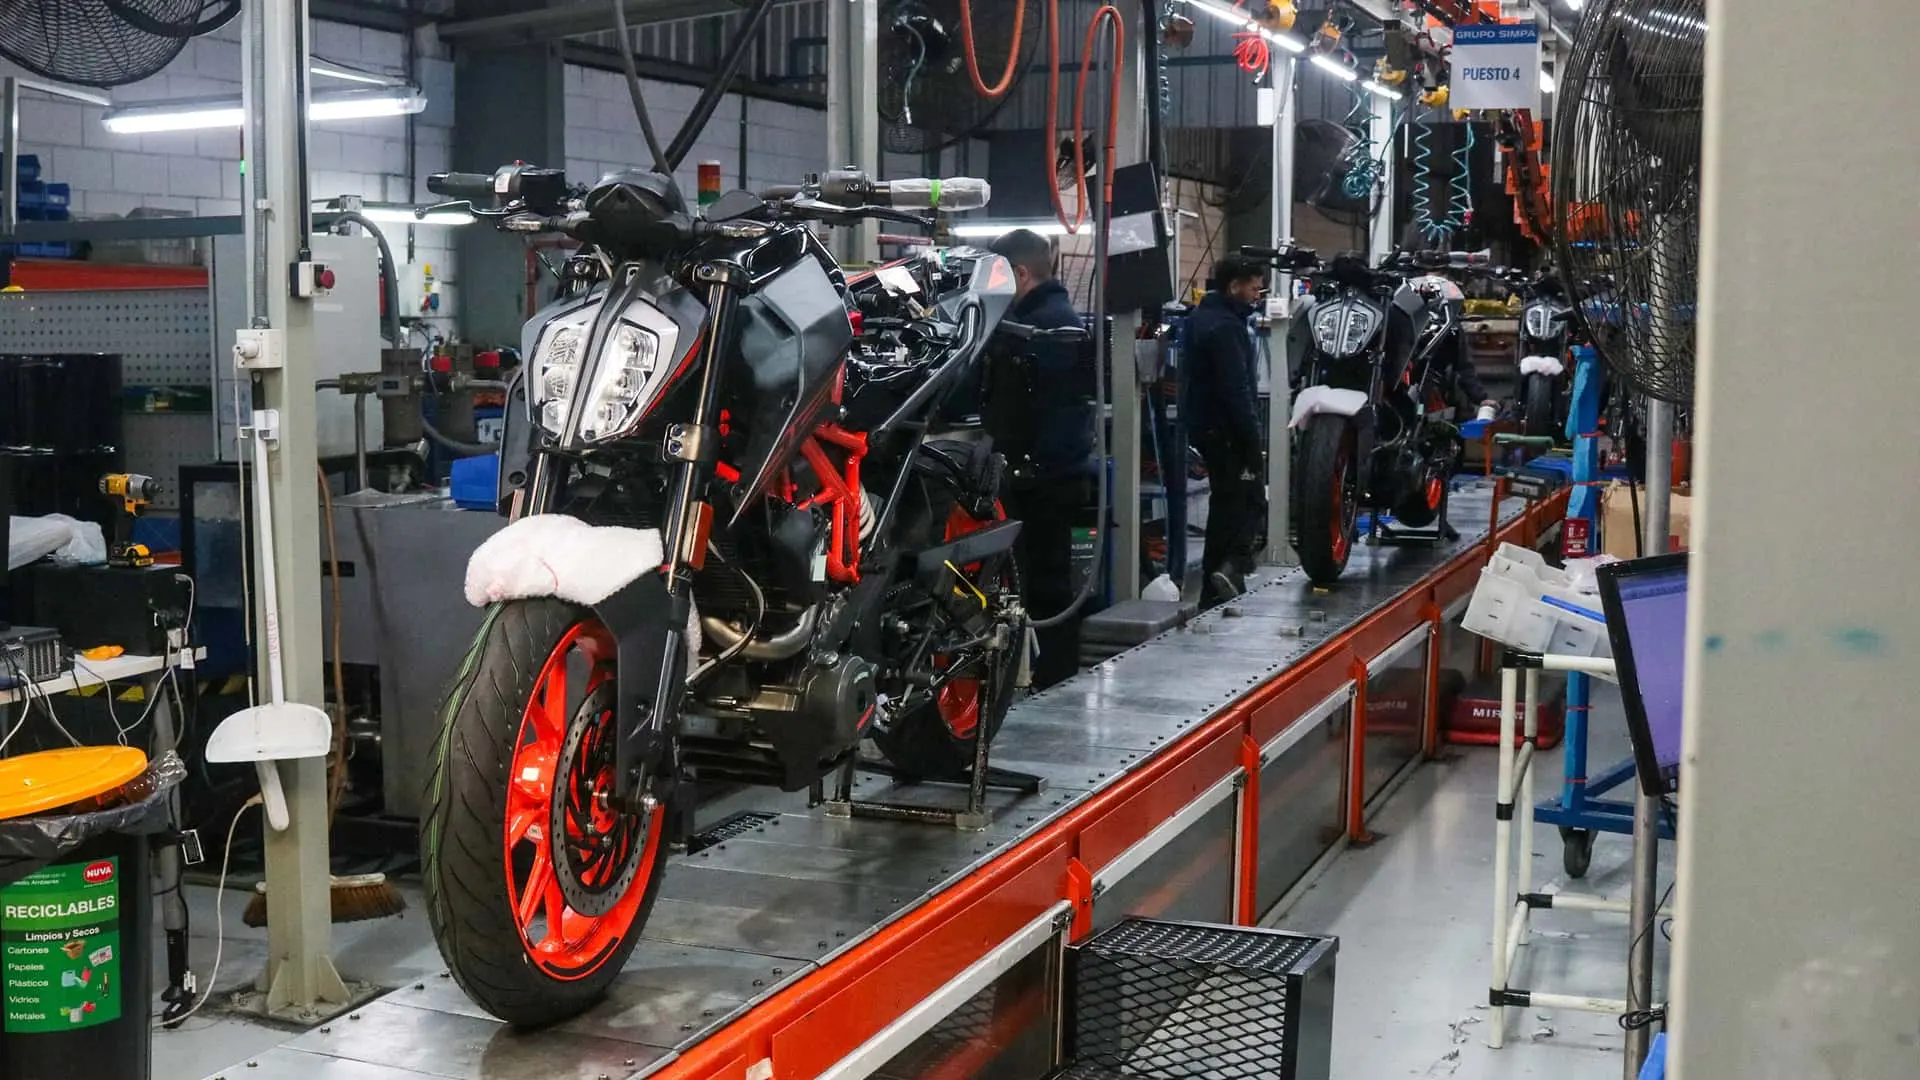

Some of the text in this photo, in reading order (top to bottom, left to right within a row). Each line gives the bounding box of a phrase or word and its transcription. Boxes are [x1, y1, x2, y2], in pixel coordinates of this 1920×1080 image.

[1456, 30, 1536, 39] GRUPO SIMPA
[1463, 67, 1520, 81] PUESTO 4
[86, 866, 112, 878] NUVA
[6, 895, 115, 918] RECICLABLES
[25, 926, 100, 942] Limpios y Secos
[8, 963, 44, 972] Papeles
[9, 979, 49, 987] Plásticos
[9, 996, 40, 1004] Vidrios
[10, 1012, 46, 1021] Metales
